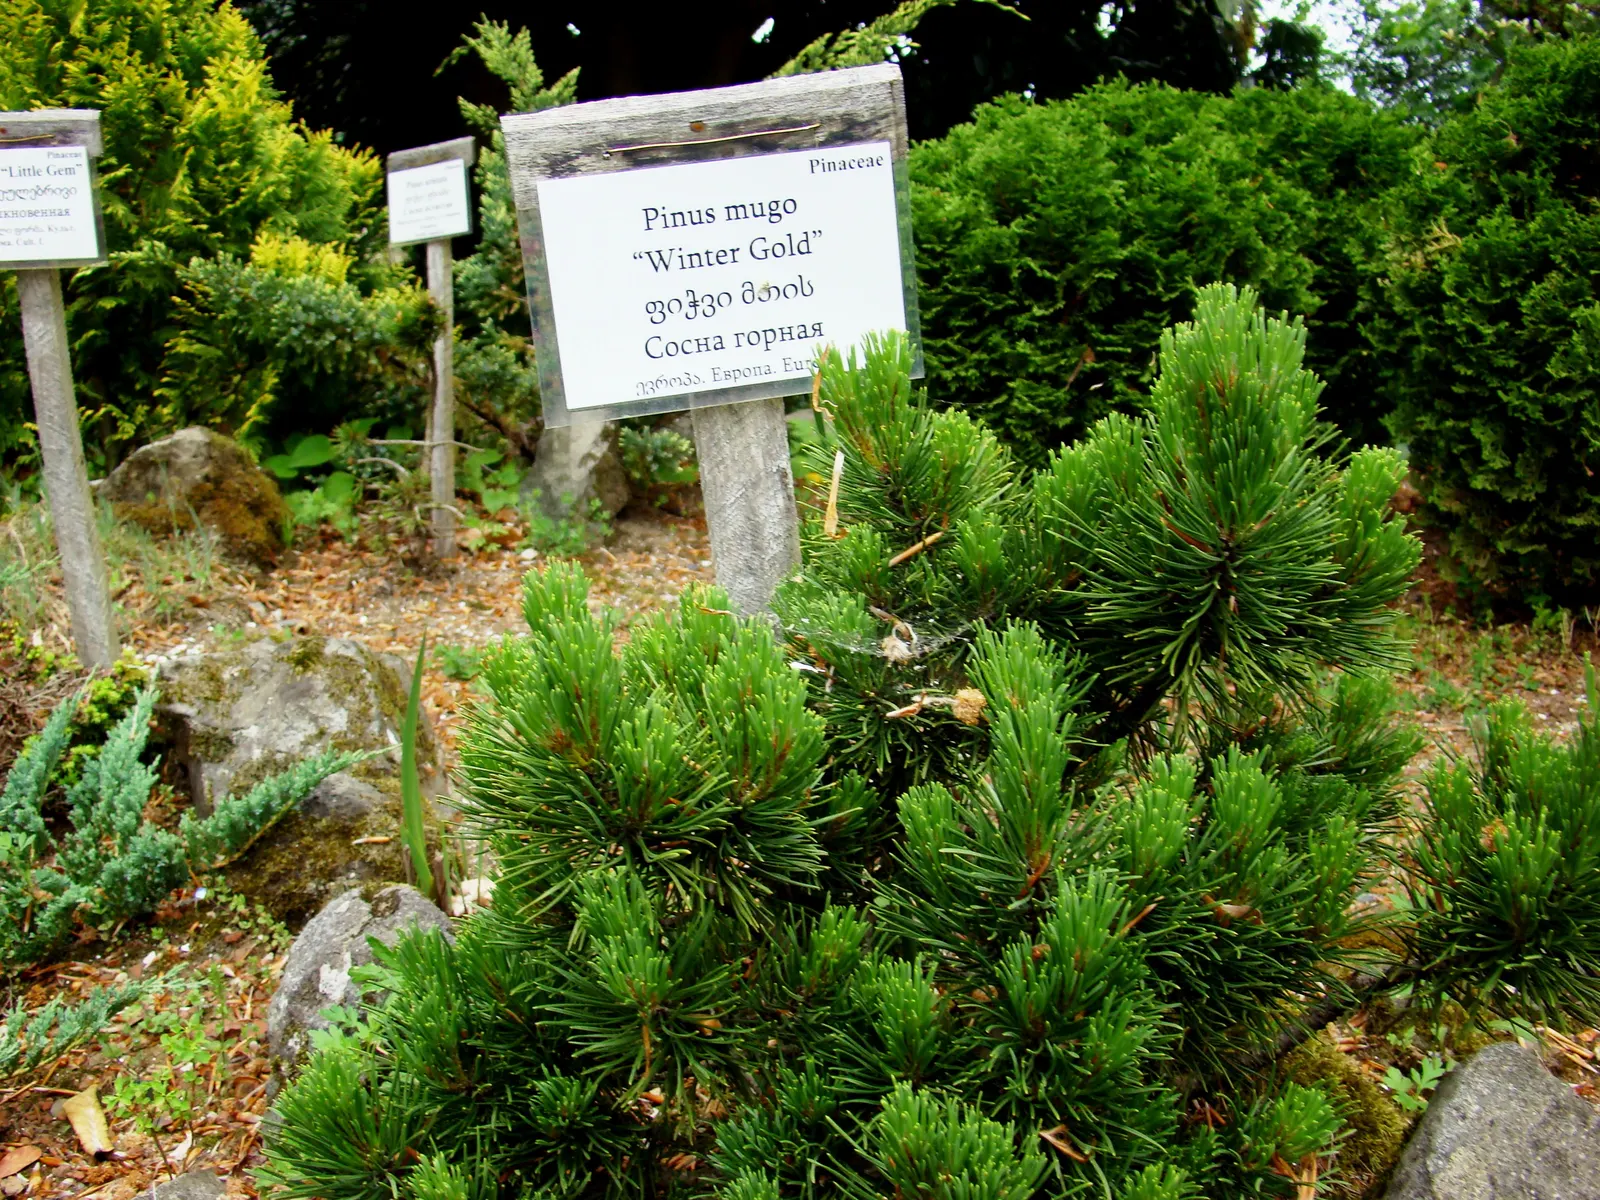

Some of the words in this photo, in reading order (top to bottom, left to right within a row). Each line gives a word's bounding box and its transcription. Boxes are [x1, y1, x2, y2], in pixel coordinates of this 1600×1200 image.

[810, 154, 885, 174] Pinaceae
[642, 206, 716, 232] Pinus
[724, 198, 797, 225] mugo
[633, 246, 741, 274] “Winter
[749, 229, 823, 261] Gold”
[644, 289, 733, 325] ფიჭვი
[741, 274, 815, 305] მთის
[644, 336, 726, 360] Сосна
[733, 320, 824, 352] горная
[711, 362, 777, 384] Европа.
